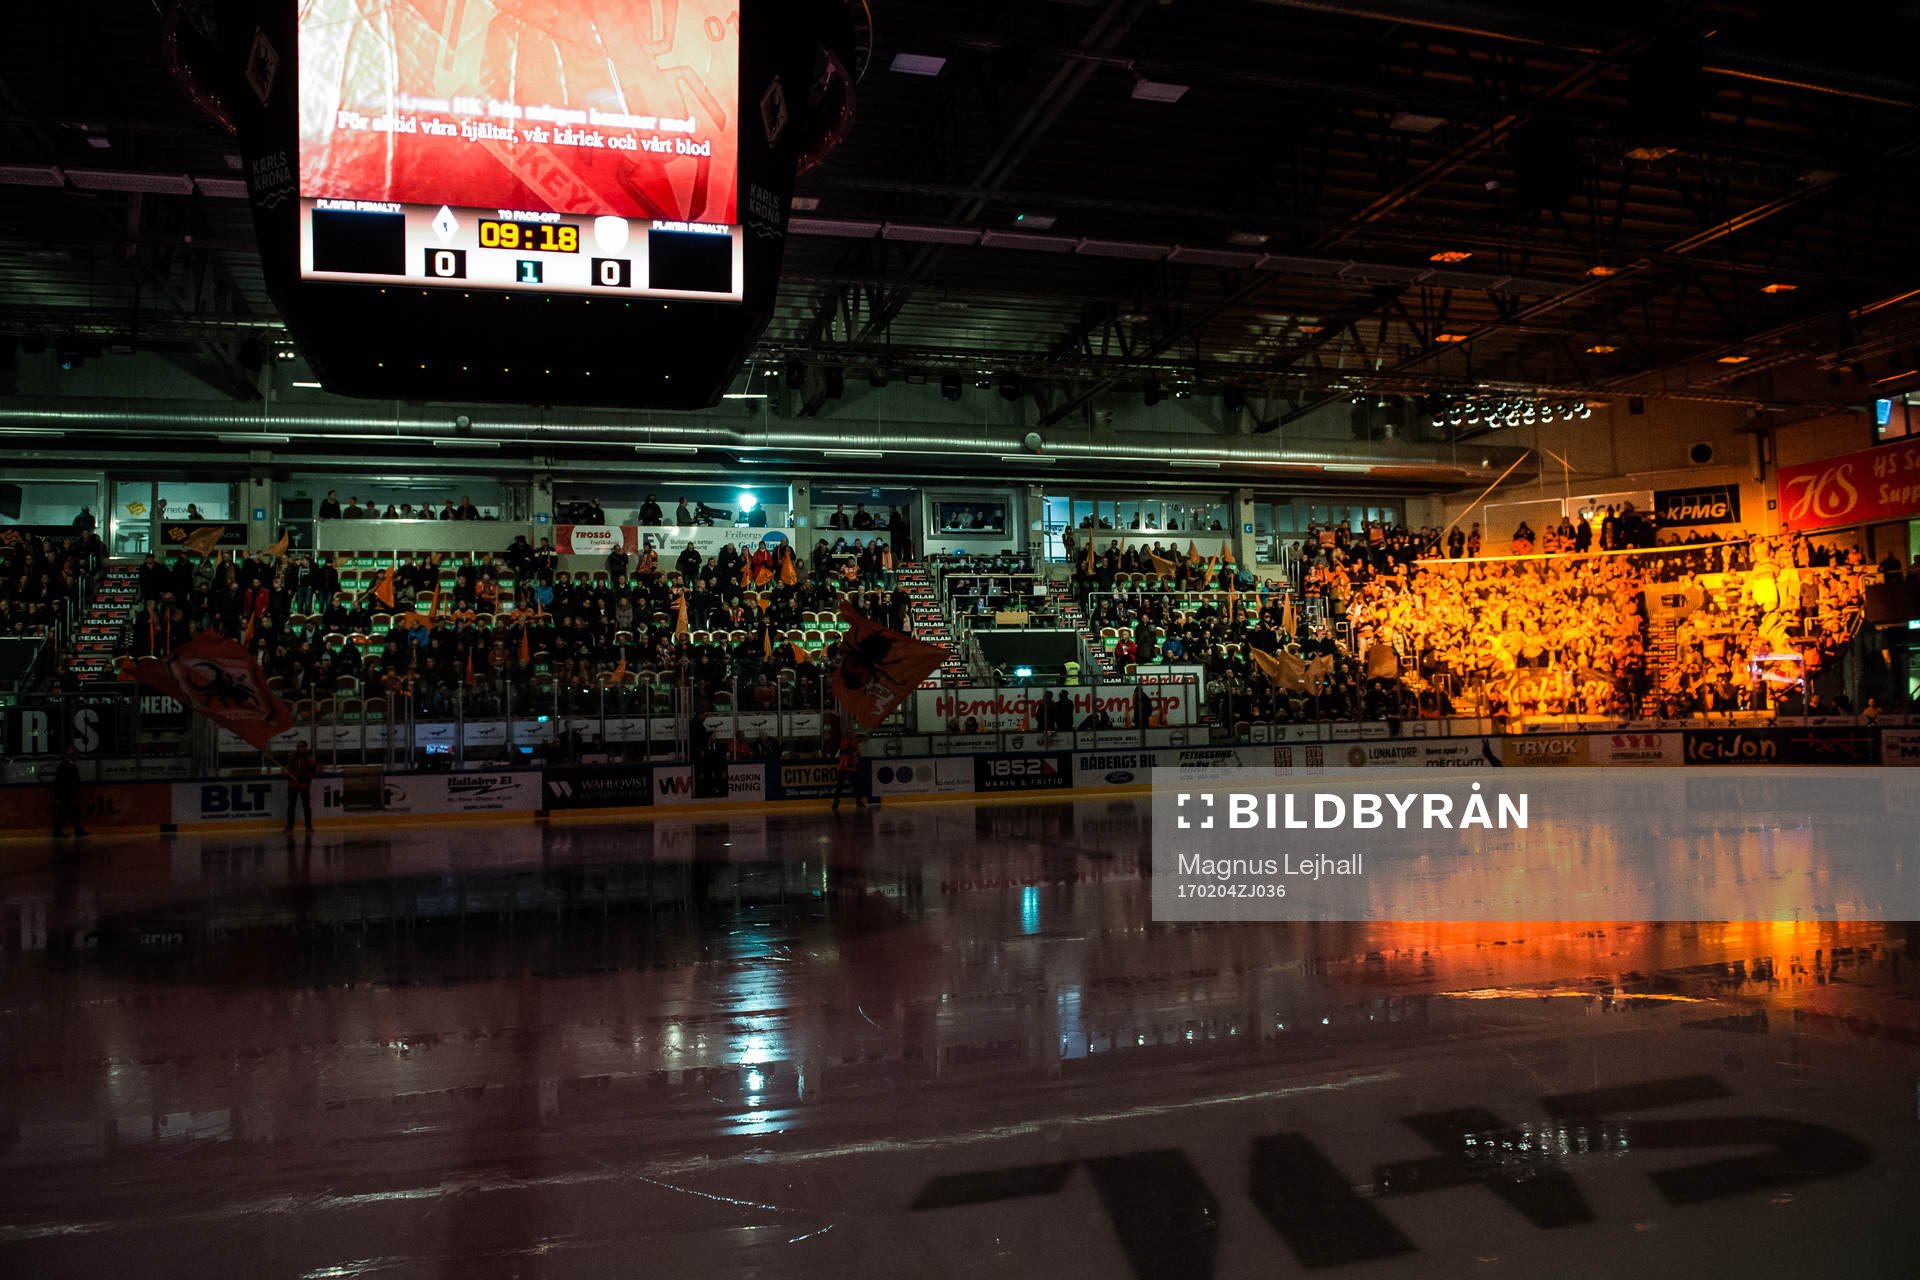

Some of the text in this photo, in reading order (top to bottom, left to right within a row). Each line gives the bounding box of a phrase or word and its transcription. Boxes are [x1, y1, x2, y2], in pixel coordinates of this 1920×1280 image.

[338, 110, 711, 156] För alltid våra hjältar, vår kärlek och vårt blod
[252, 151, 287, 176] KARLS
[254, 168, 291, 192] KRONA
[317, 199, 355, 210] PLAYER
[750, 182, 781, 209] KARLS
[498, 210, 512, 220] TO
[750, 198, 781, 224] KRONA
[653, 220, 688, 231] PLAYER
[480, 222, 577, 252] 09:18
[434, 251, 455, 276] 0
[522, 261, 538, 283] 1
[601, 262, 620, 284] 0
[1873, 451, 1898, 478] HS
[1667, 502, 1727, 521] KPMG
[643, 532, 670, 550] EY
[1074, 691, 1180, 714] Hemöp
[1512, 739, 1577, 756] TRYCK
[1611, 735, 1662, 748] SYD
[987, 759, 1042, 777] 1852
[1080, 754, 1157, 770] RÅBERGS BIL
[581, 777, 648, 790] WAHLQVIST
[785, 767, 838, 785] CITY GRO
[201, 784, 271, 812] BLT
